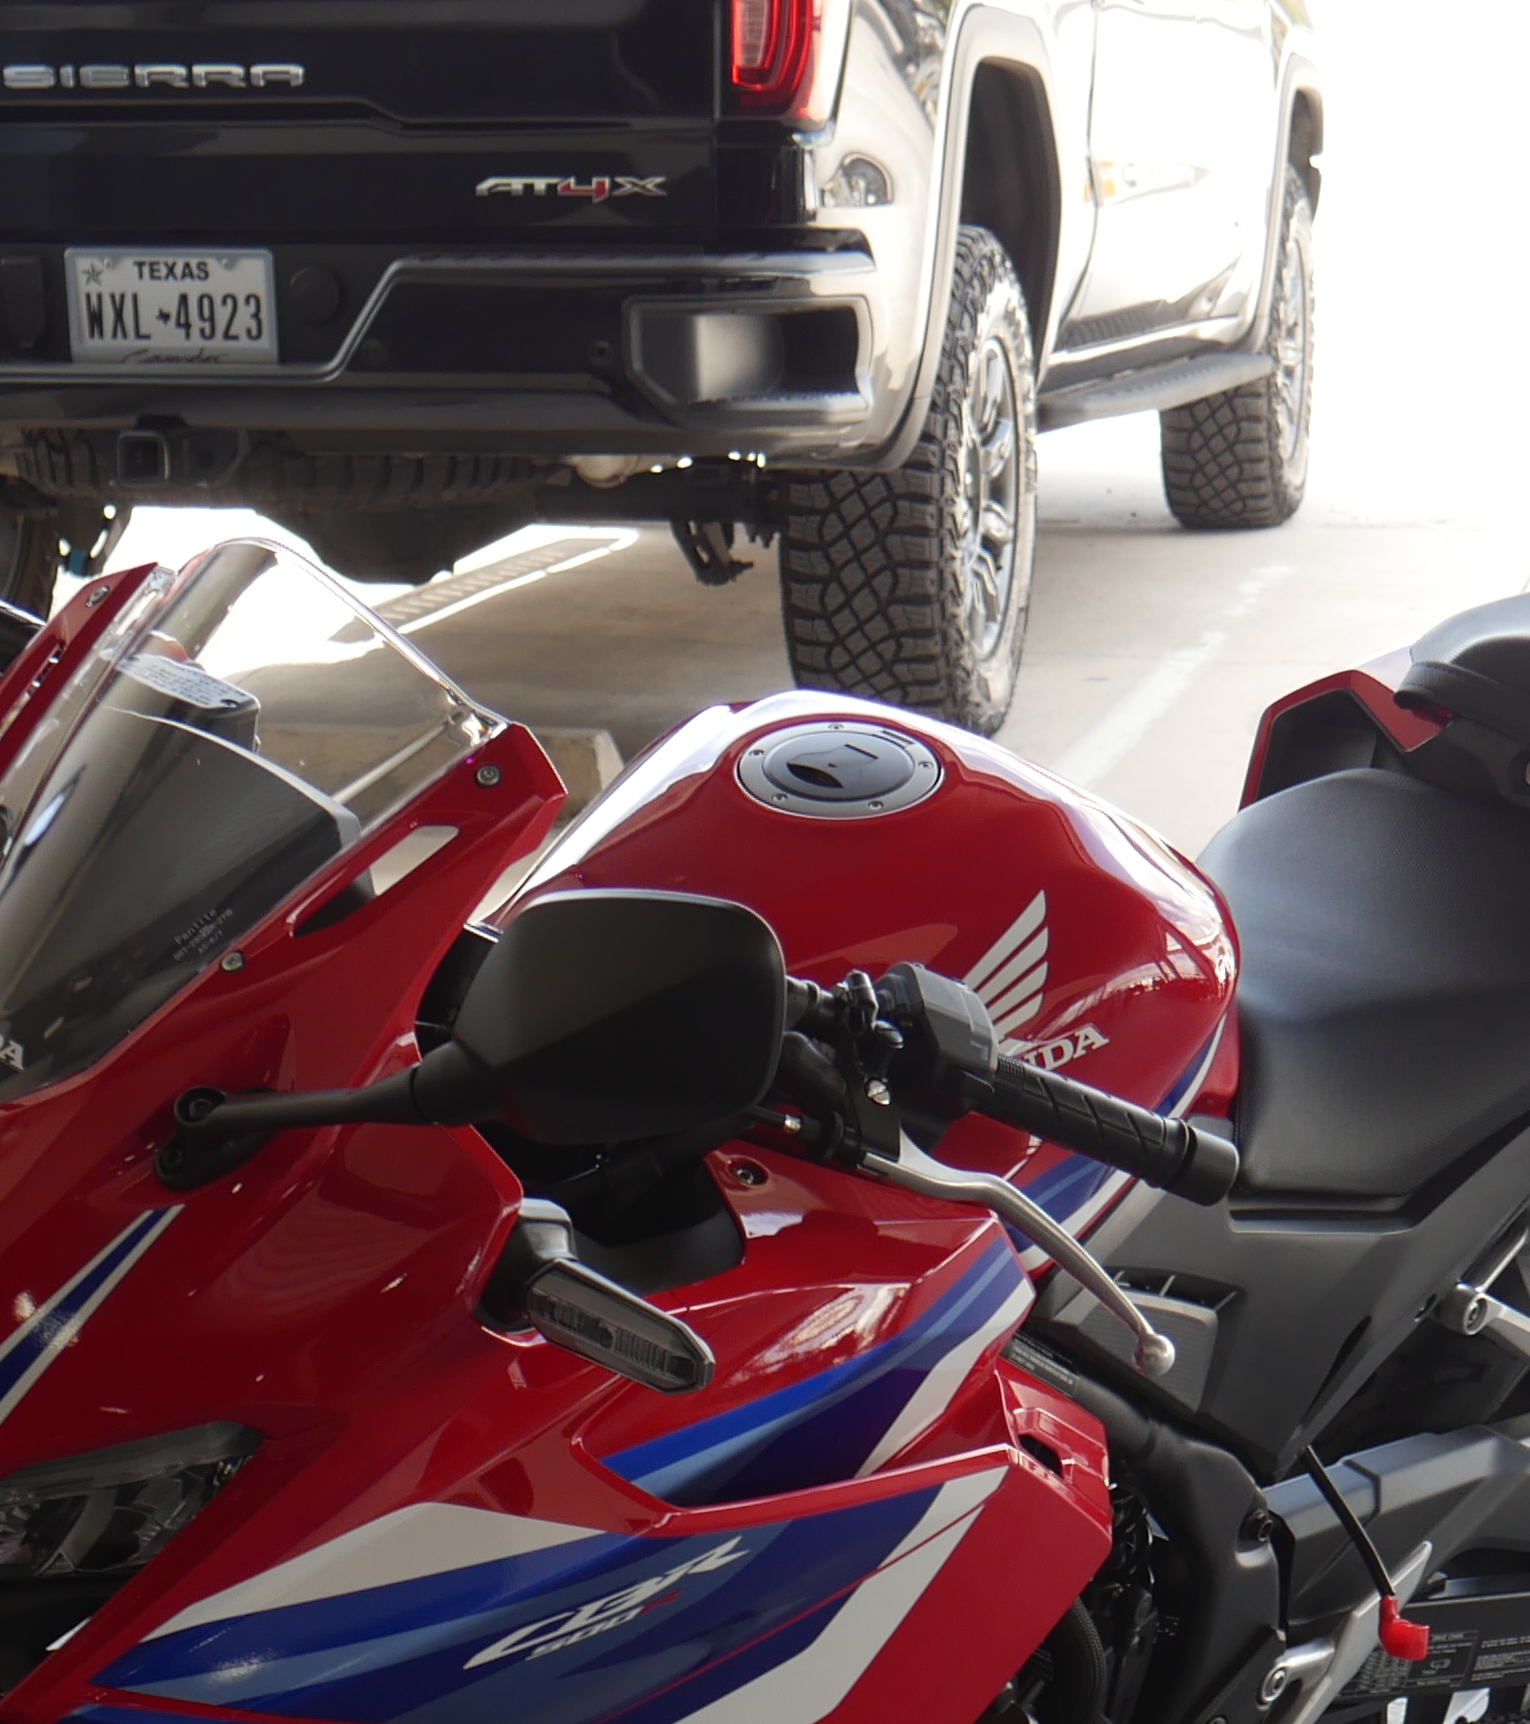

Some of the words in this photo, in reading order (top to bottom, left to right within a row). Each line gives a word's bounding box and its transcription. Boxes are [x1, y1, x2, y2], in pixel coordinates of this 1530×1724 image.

[3, 64, 305, 89] SIERRA
[475, 176, 667, 203] AT4X
[133, 260, 209, 280] TEXAS
[85, 292, 151, 340] WXL
[175, 292, 264, 340] 4923
[462, 1535, 750, 1670] CBR
